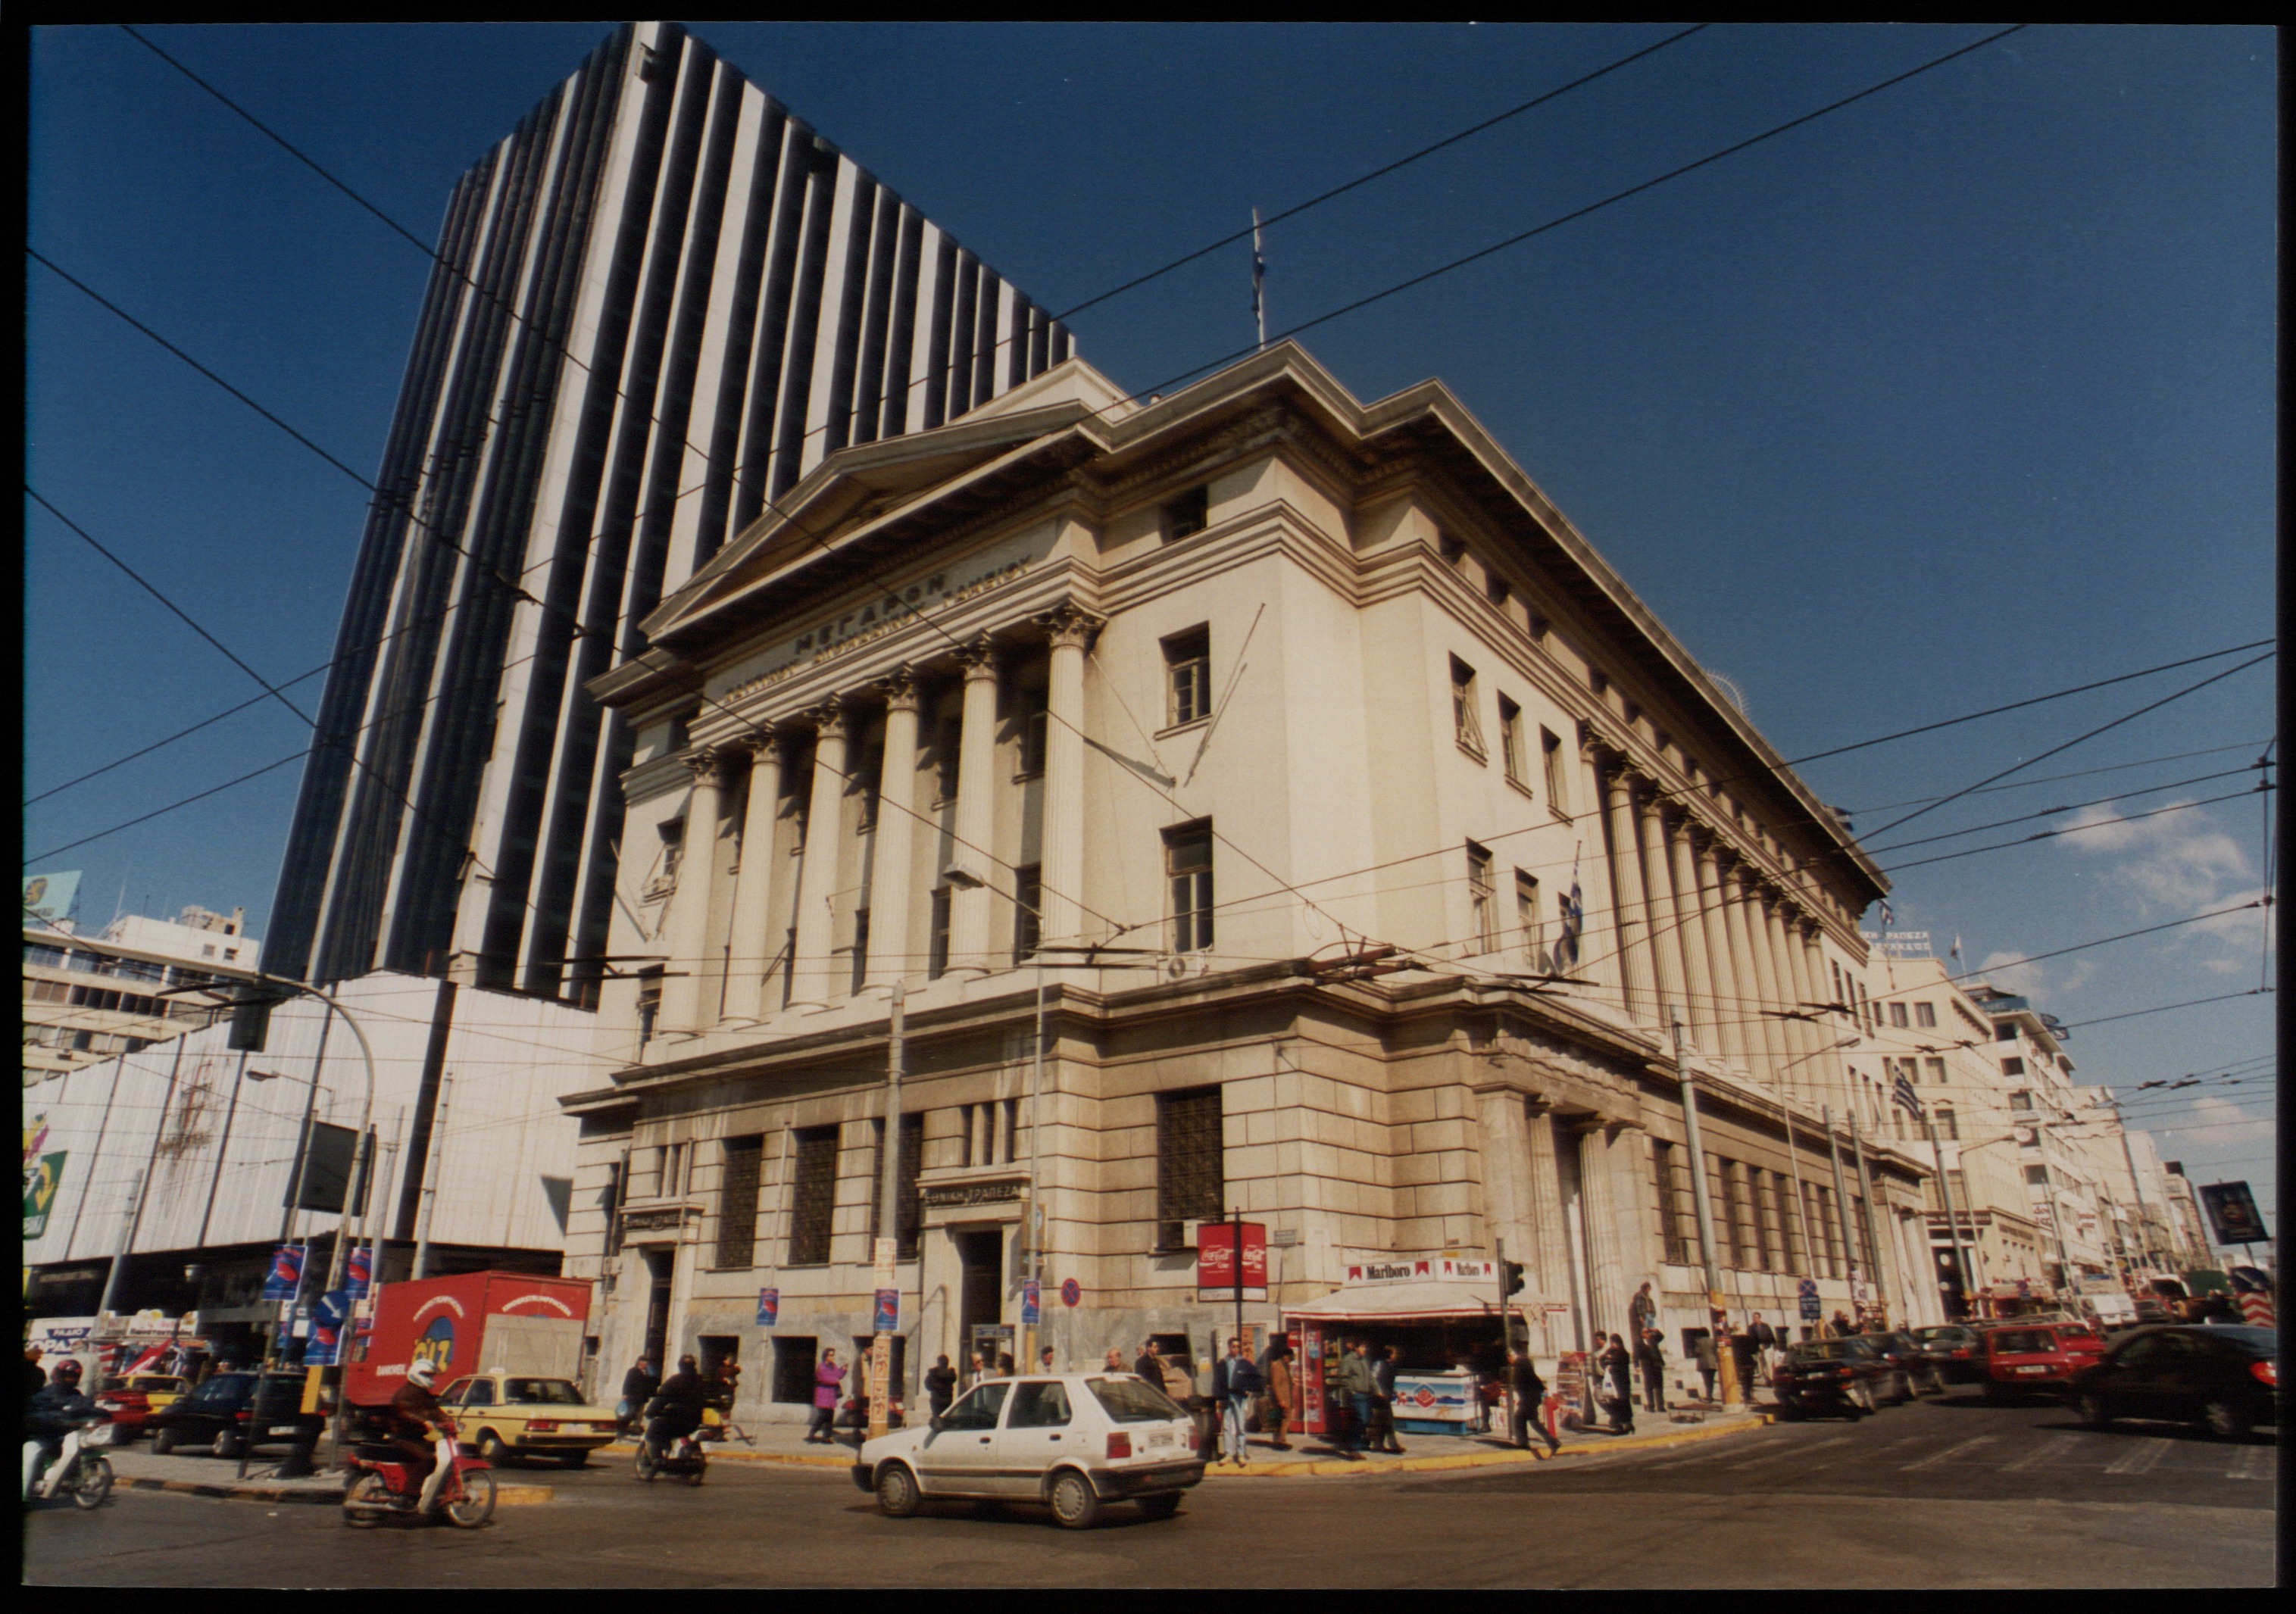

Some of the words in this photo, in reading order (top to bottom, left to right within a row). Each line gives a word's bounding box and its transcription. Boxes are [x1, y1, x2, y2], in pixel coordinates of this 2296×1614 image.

[795, 573, 947, 656] ΜΕΓΑΡΟΝ
[924, 1190, 964, 1203] ΕΘΝΙΚΗ
[969, 1185, 1019, 1200] ΤΡΑΠΕΖΑ
[1367, 1264, 1410, 1280] Marlboro
[1456, 1263, 1480, 1276] Marlboro
